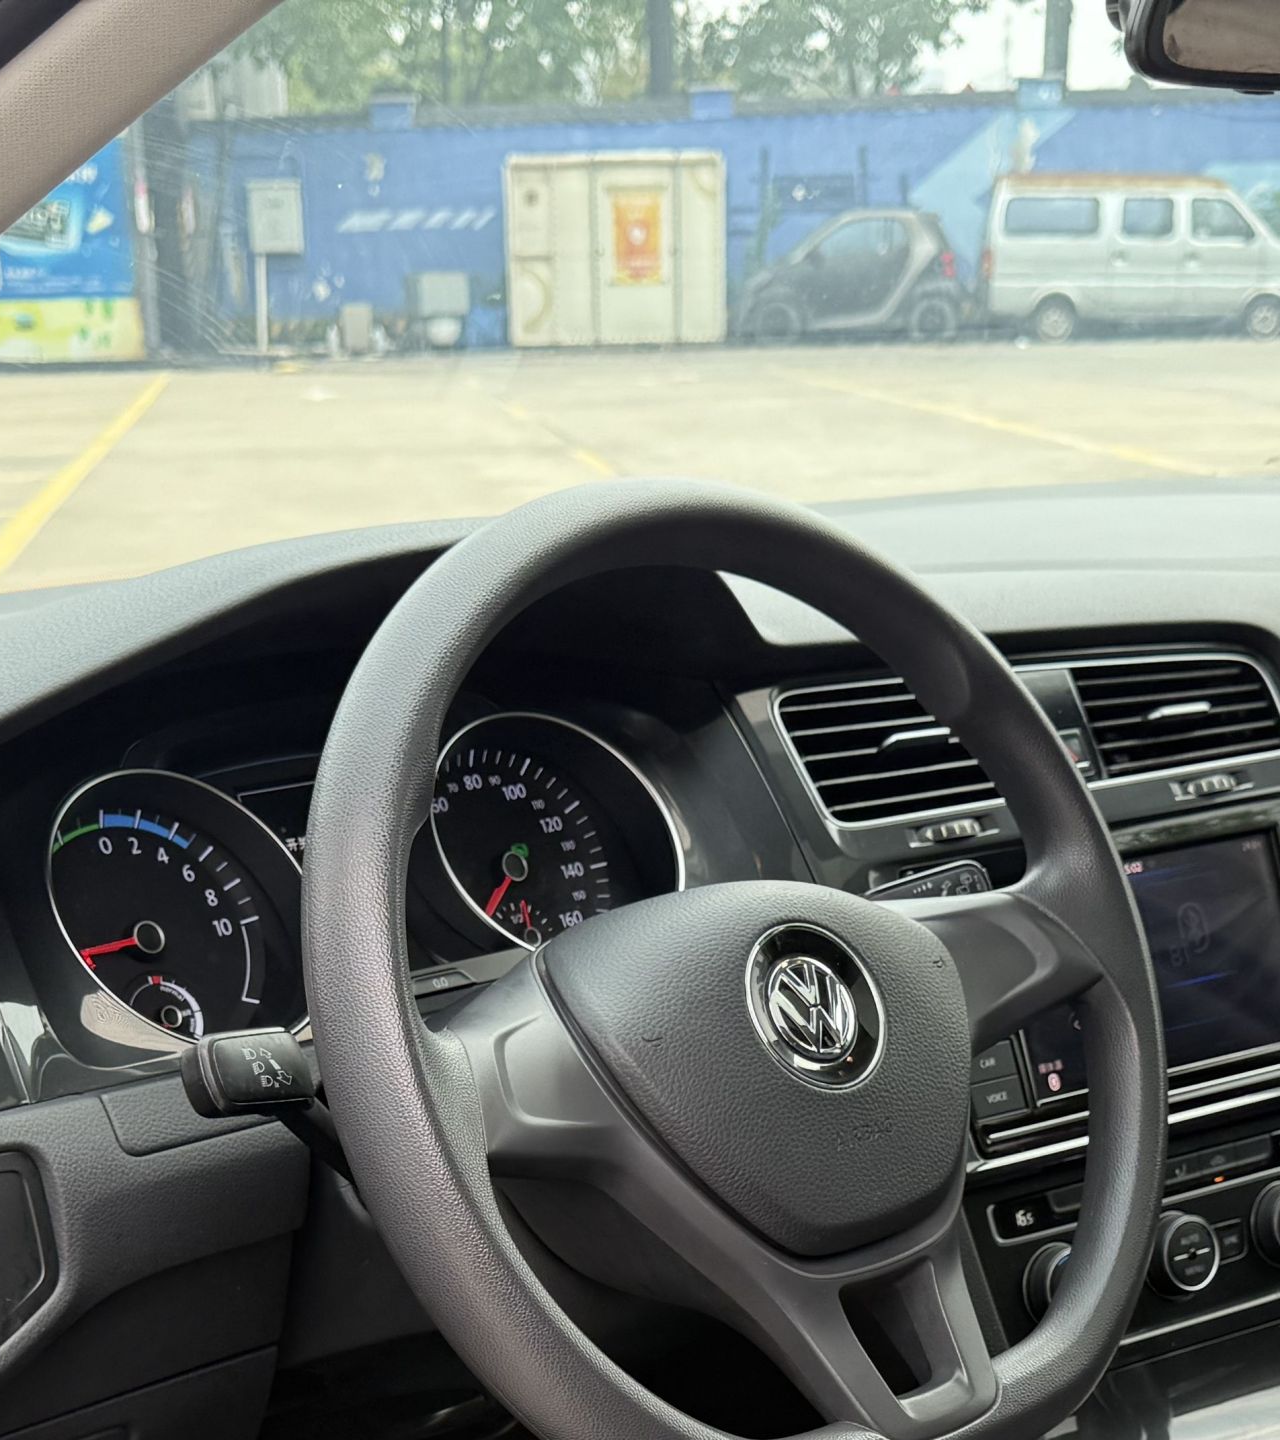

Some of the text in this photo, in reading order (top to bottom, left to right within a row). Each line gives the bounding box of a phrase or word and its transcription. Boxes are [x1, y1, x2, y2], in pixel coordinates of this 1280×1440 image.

[463, 773, 483, 791] 80
[488, 775, 502, 786] 90
[501, 783, 527, 801] 100
[531, 799, 546, 810] 110
[539, 816, 563, 834] 120
[98, 836, 113, 854] 0
[127, 837, 142, 854] 2
[157, 847, 170, 864] 4
[182, 864, 195, 882] 6
[560, 861, 584, 879] 140
[204, 888, 218, 907] 8
[212, 918, 233, 936] 10
[559, 910, 583, 928] 160
